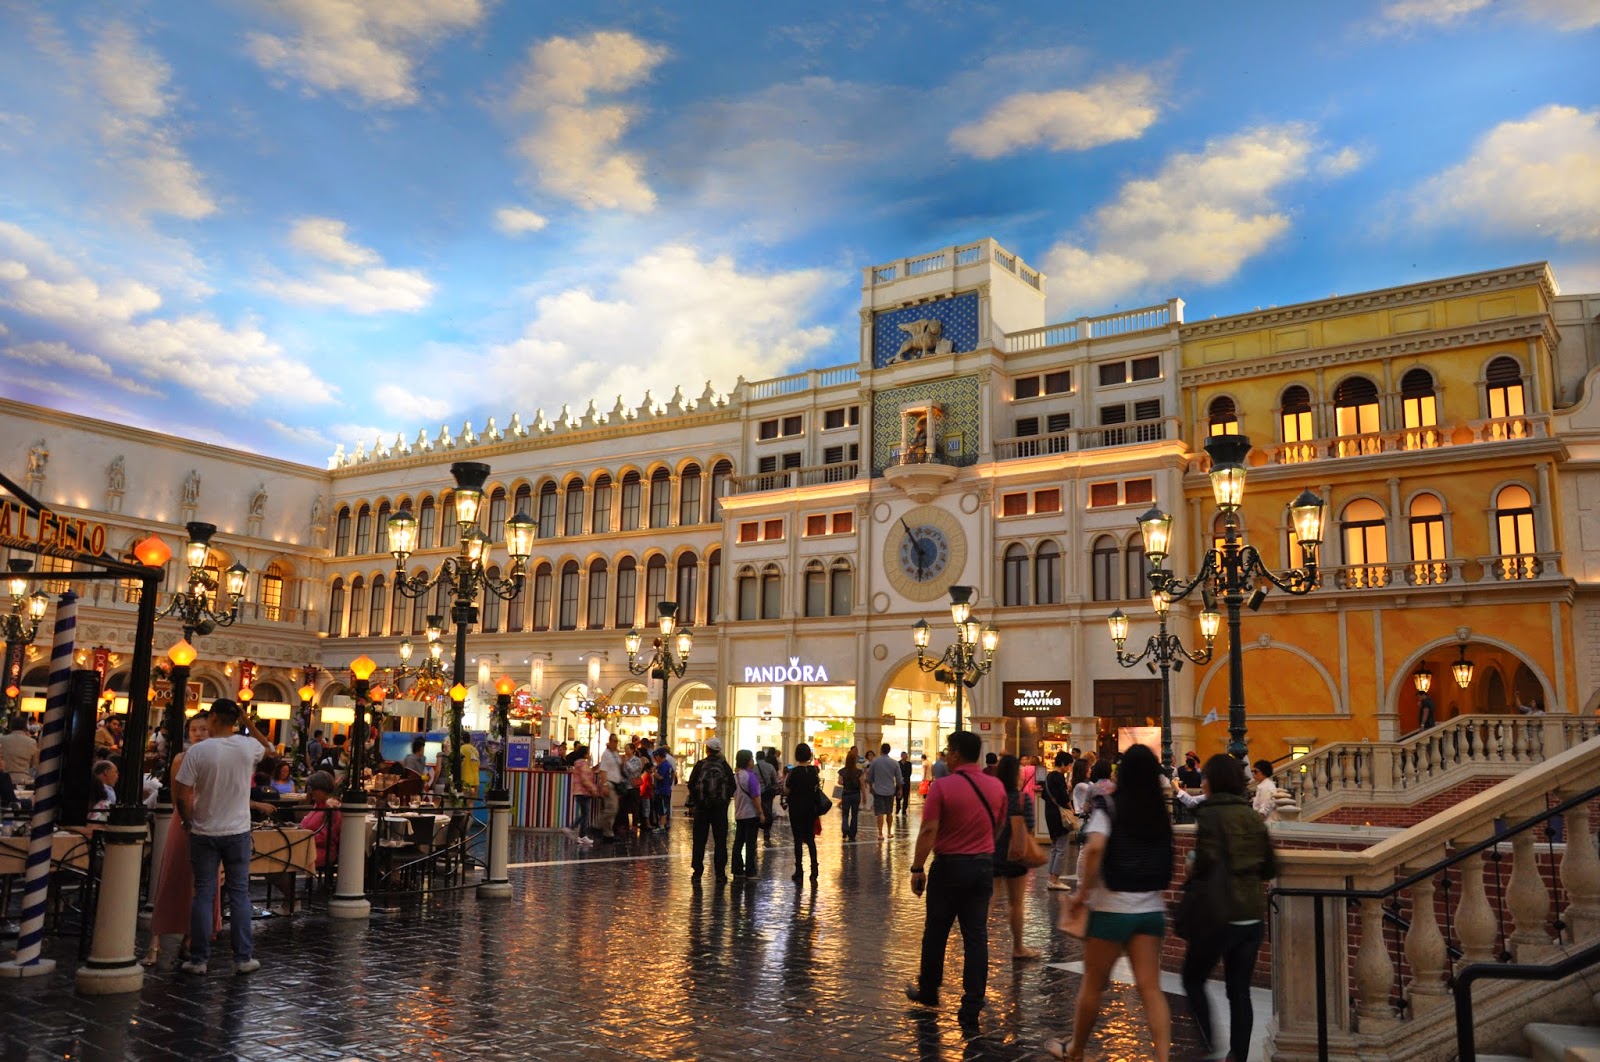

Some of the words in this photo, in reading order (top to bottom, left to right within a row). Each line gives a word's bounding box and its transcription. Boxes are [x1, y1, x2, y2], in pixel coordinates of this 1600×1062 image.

[744, 665, 828, 682] PANDORA
[1024, 690, 1046, 698] ART
[1013, 698, 1061, 706] SHAVING
